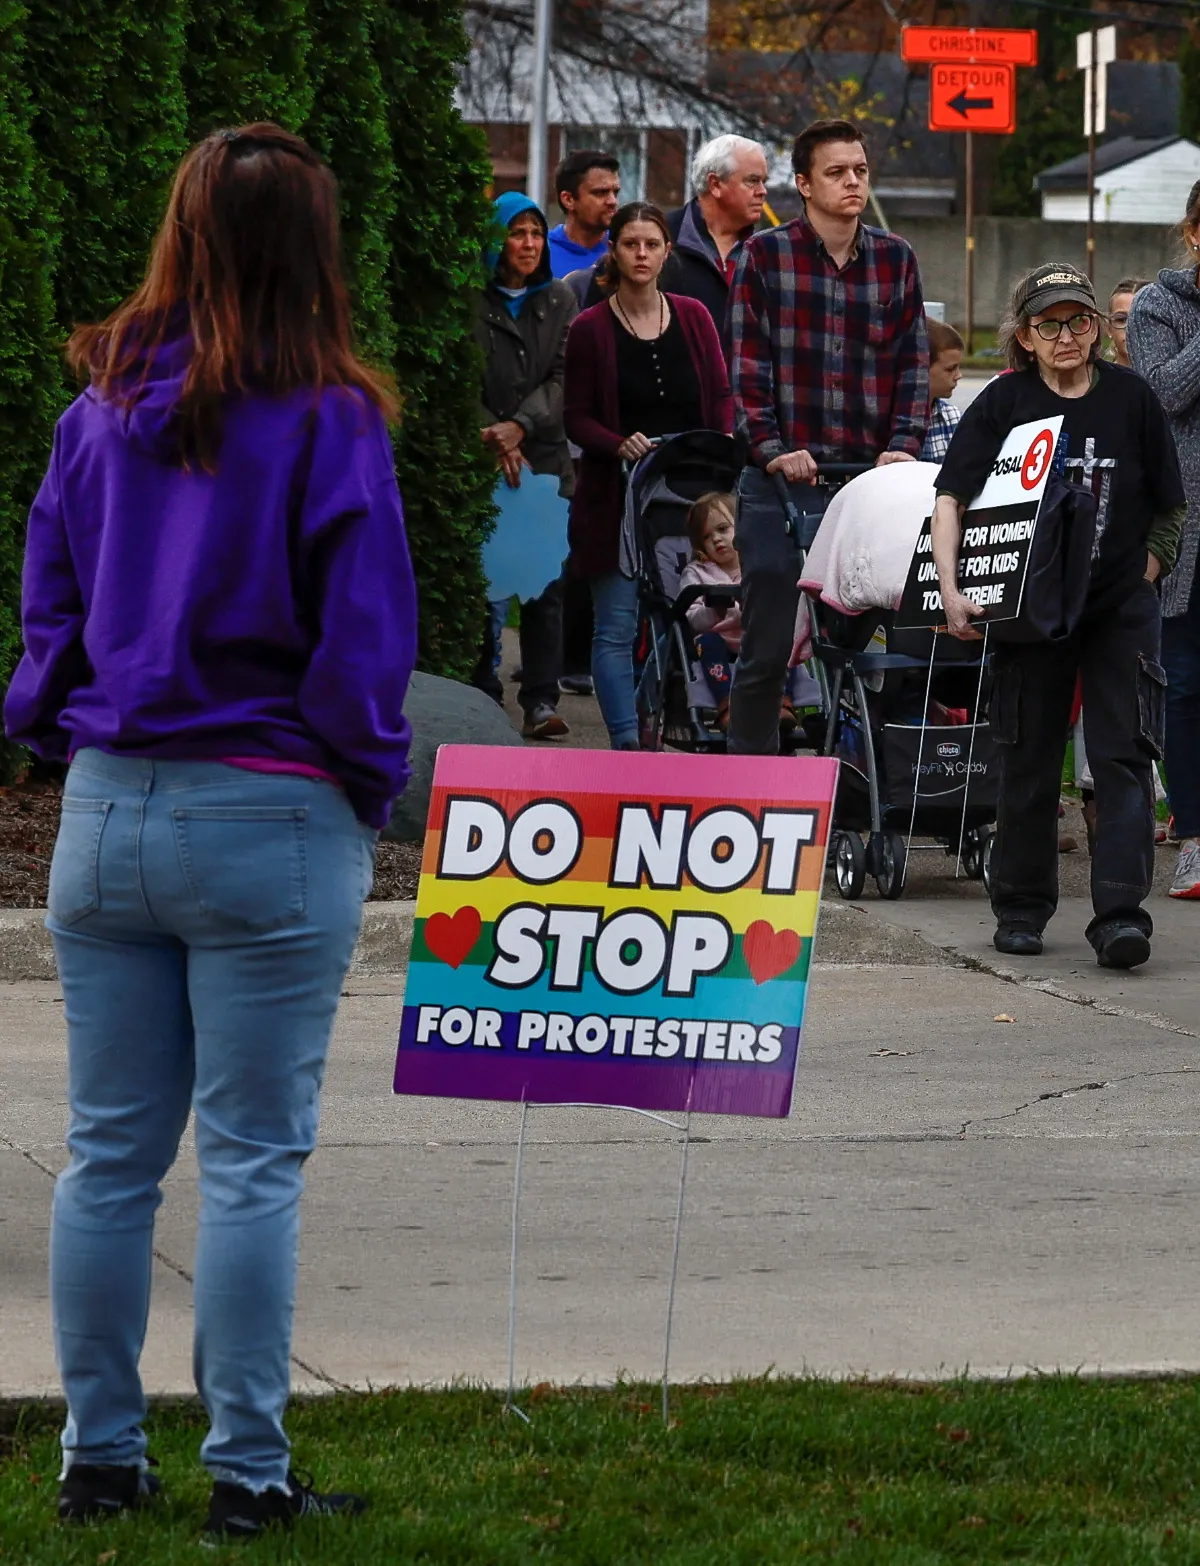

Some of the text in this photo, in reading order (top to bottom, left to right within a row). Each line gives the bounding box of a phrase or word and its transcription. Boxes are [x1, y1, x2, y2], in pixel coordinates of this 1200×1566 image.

[929, 36, 1006, 53] CHRISTINE
[936, 70, 1005, 87] DETOUR
[1026, 438, 1048, 481] 3
[963, 519, 1035, 548] FOR WOMEN
[965, 555, 990, 577] FOR
[991, 551, 1020, 574] KIDS
[922, 590, 944, 611] TO
[955, 761, 987, 775] Caddy
[436, 795, 819, 895] DO NOT
[484, 902, 733, 998] STOP
[416, 1004, 784, 1063] FOR PROTESTERS
